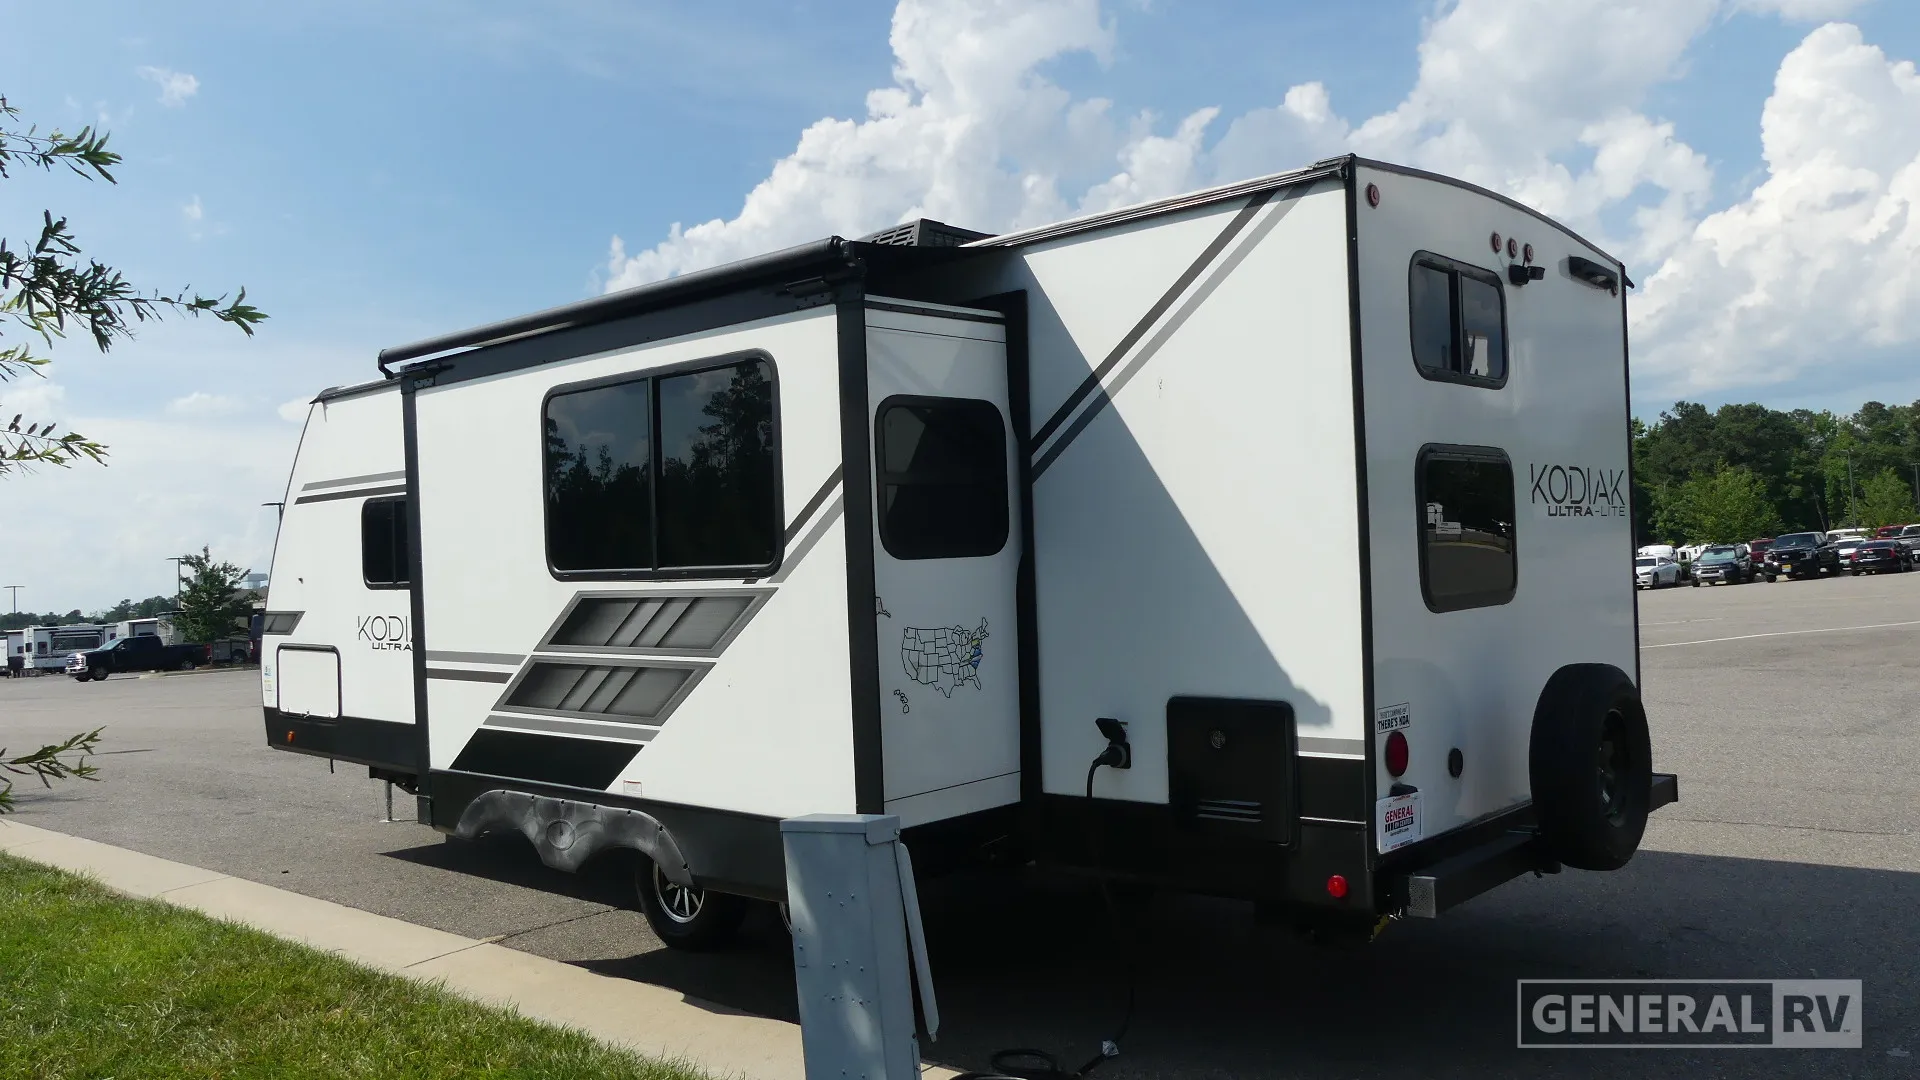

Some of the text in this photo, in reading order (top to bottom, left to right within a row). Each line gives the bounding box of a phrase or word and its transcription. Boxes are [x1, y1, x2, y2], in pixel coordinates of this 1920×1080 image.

[1530, 463, 1625, 505] KODIAK
[1547, 505, 1626, 517] ULTRA-LITE
[357, 615, 413, 642] KODI
[371, 642, 413, 651] ULTRA
[1385, 804, 1414, 823] GENERAL
